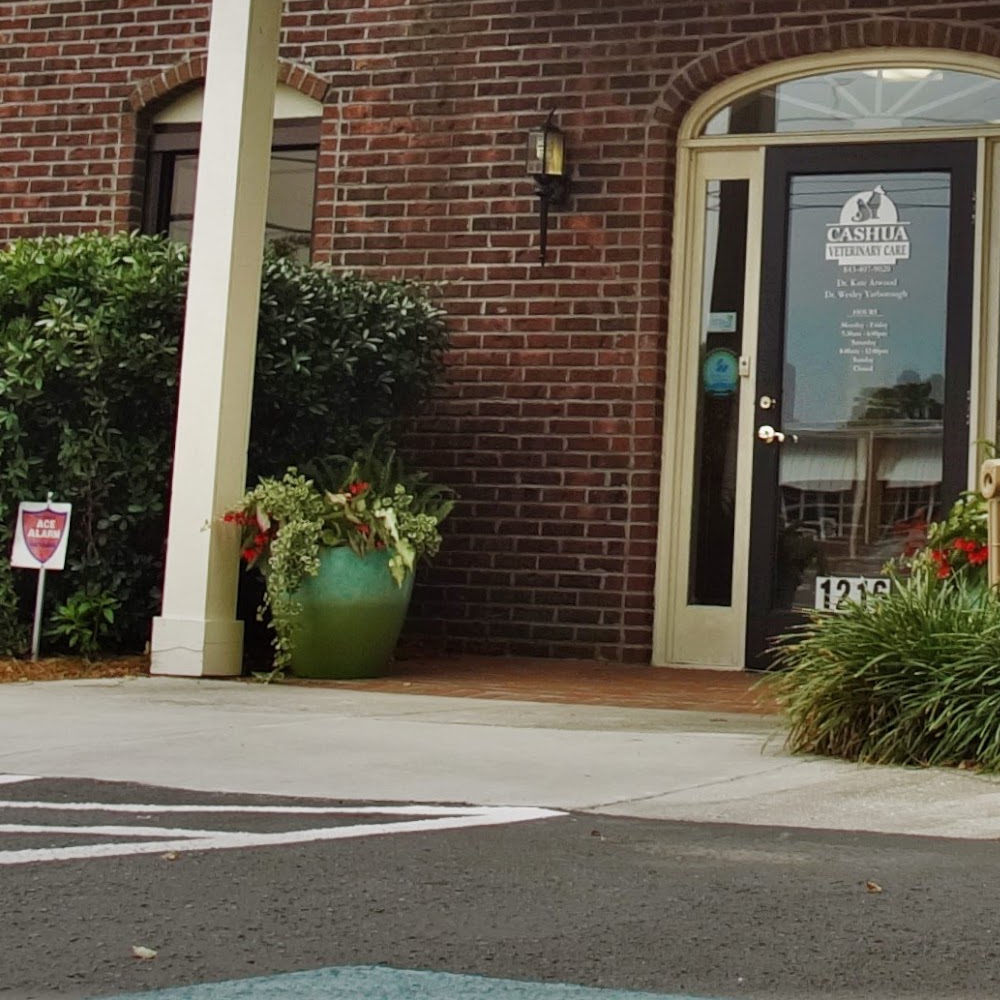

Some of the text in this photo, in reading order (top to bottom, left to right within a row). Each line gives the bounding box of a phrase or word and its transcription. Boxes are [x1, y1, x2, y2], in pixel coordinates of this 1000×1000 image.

[827, 226, 909, 242] CASHUA
[828, 244, 907, 257] VETERINARY CARE
[36, 518, 56, 529] ACE
[27, 528, 61, 539] ALARM
